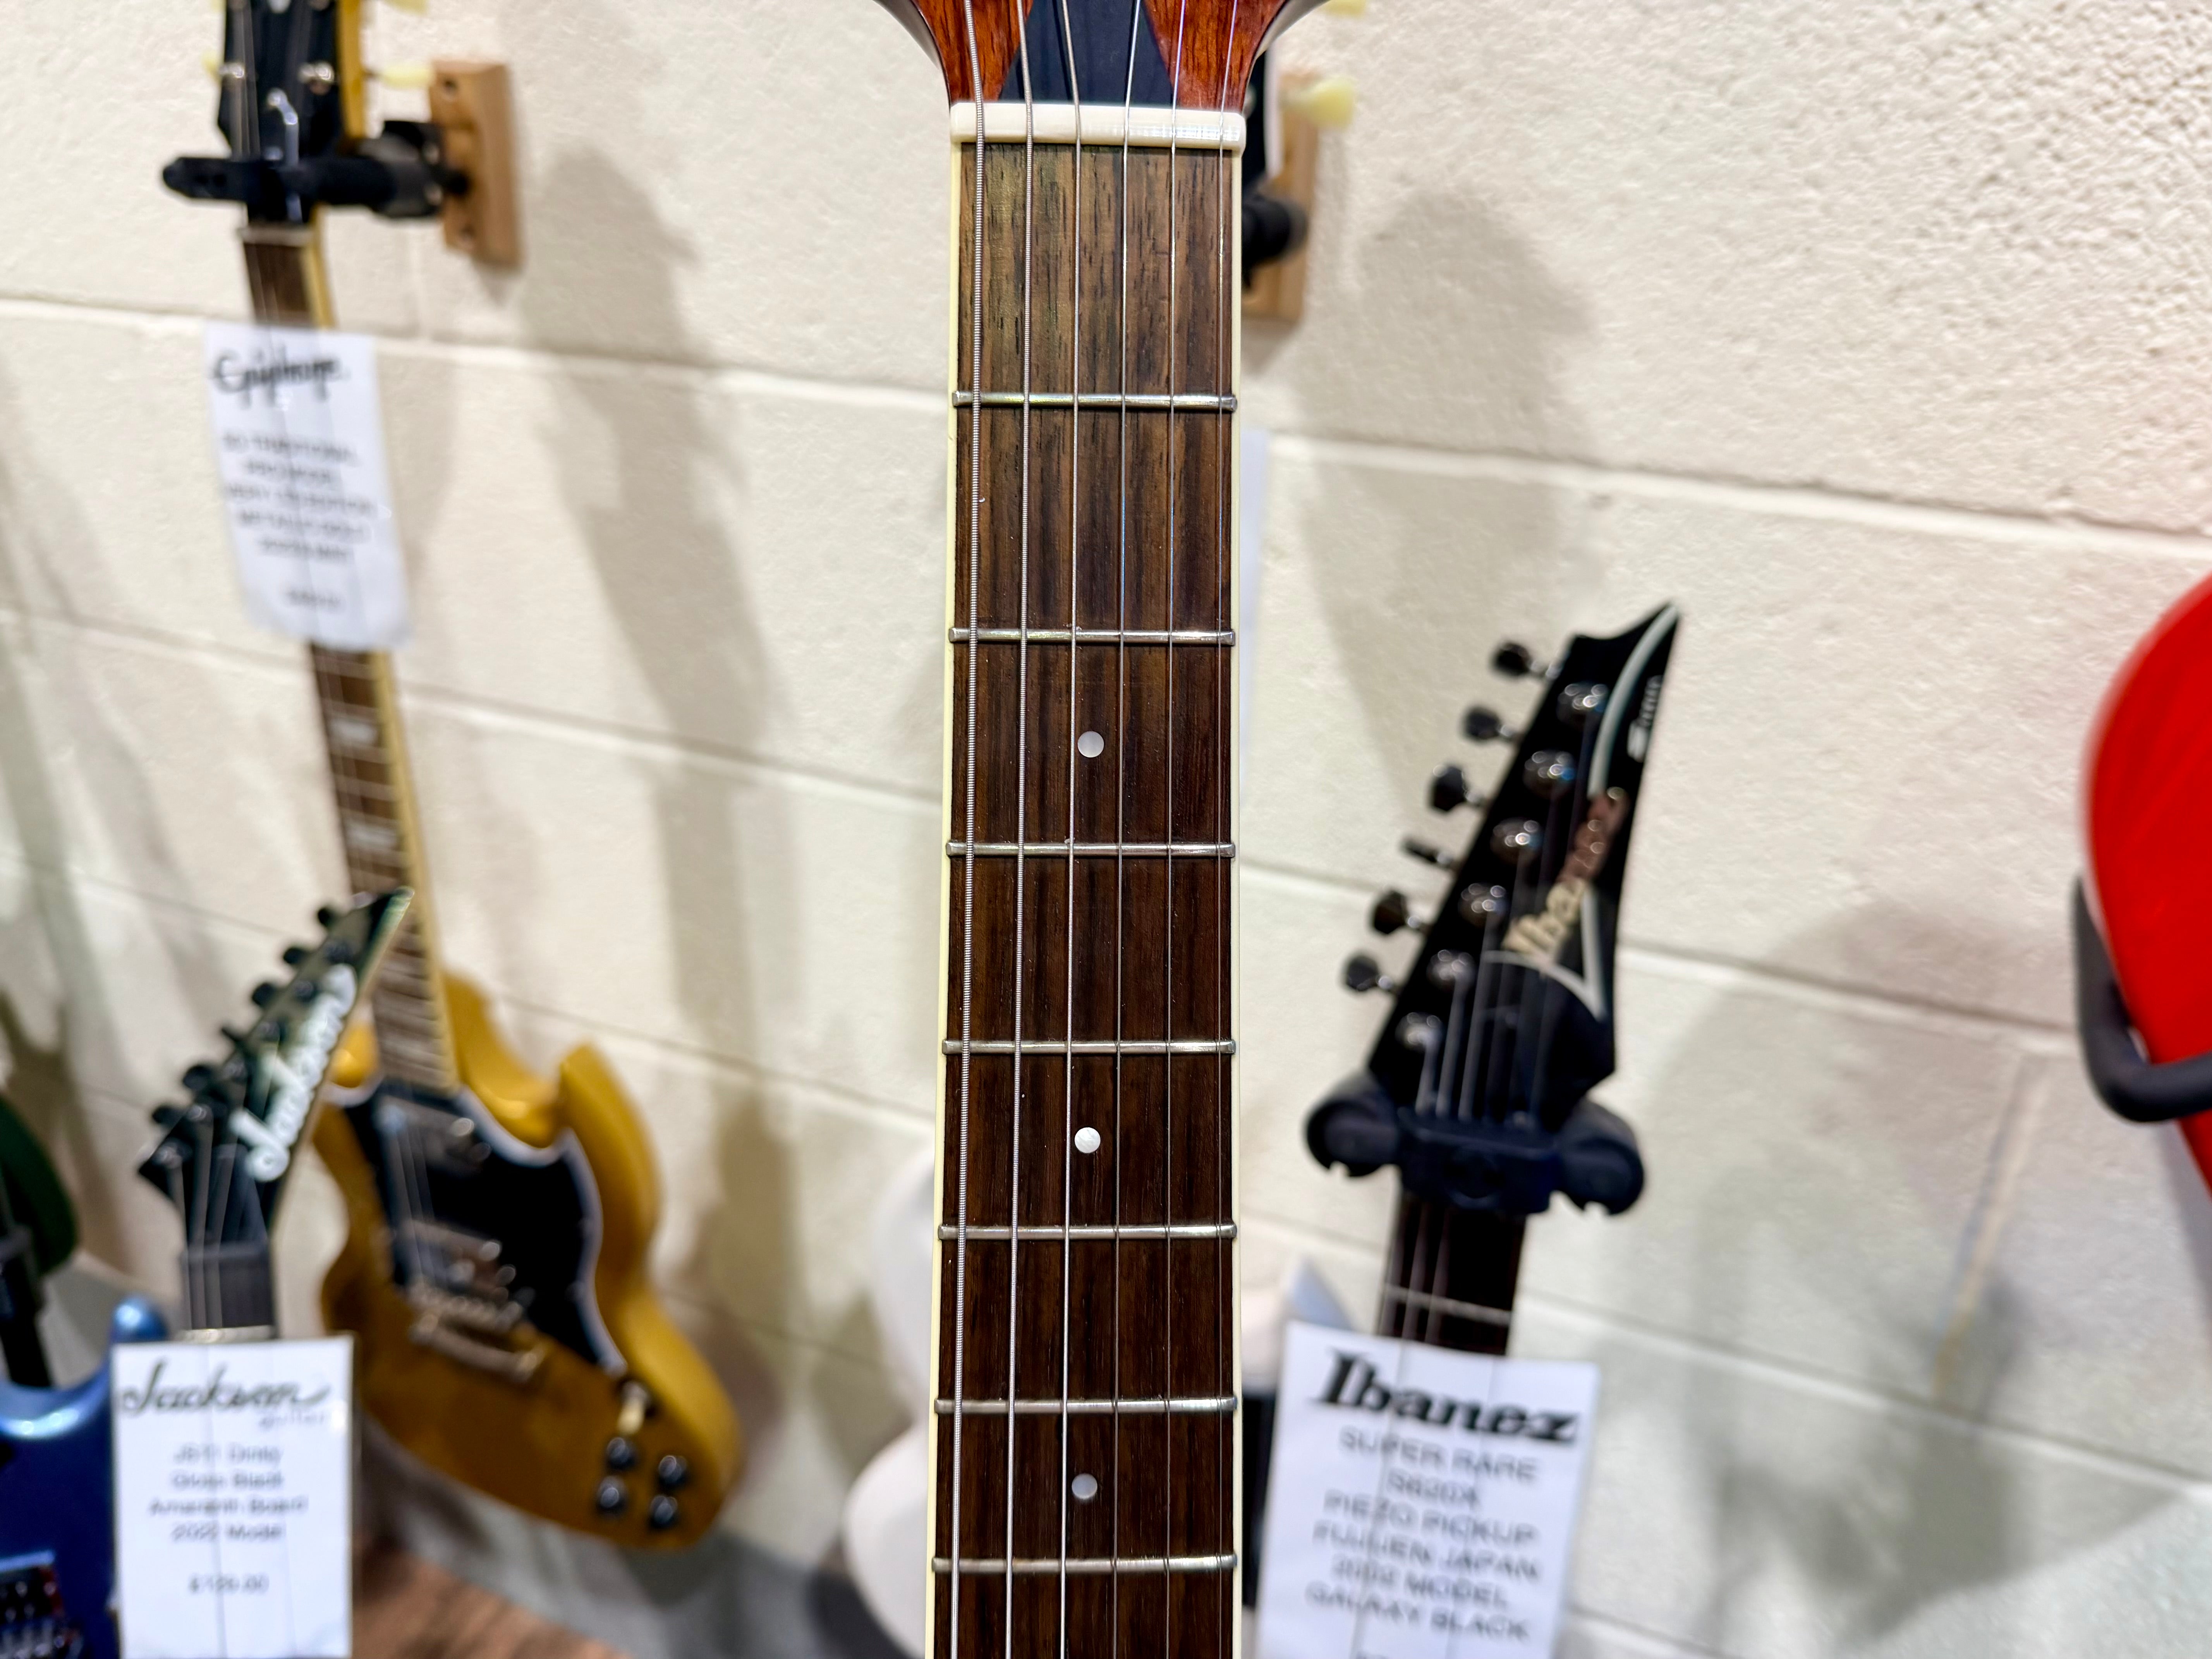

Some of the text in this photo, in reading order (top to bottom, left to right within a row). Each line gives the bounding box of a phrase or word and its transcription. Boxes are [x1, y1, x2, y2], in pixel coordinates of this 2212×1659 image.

[228, 963, 357, 1183] Jackson
[122, 1355, 333, 1415] Jackson
[1309, 1347, 1580, 1446] Ibanez
[1340, 1426, 1538, 1483] SUPER RARE
[1325, 1491, 1538, 1546] PIEZO PICKUP
[1404, 1571, 1511, 1609] MODEL
[1439, 1542, 1540, 1582] JAPAN
[1432, 1604, 1530, 1641] BLACK
